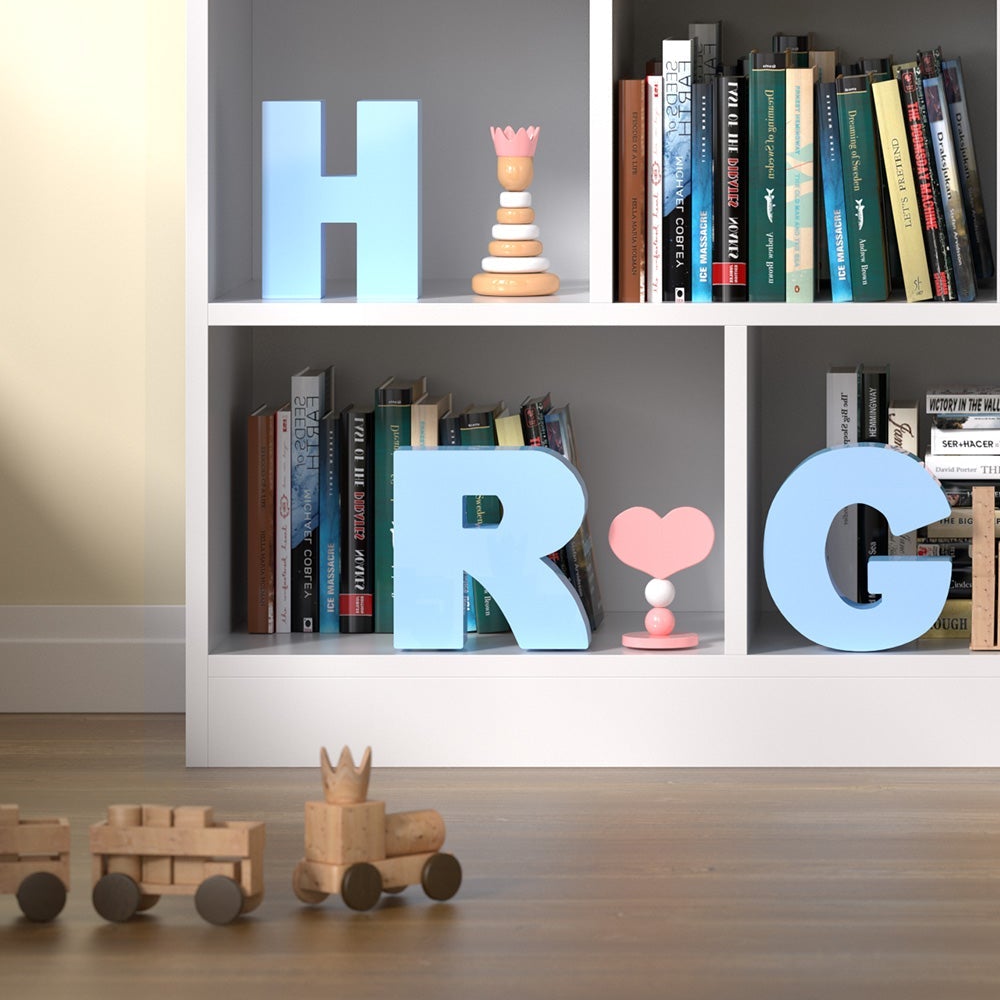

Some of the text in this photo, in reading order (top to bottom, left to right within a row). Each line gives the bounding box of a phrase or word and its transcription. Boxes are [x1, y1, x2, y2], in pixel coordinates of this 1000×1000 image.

[848, 110, 858, 149] Dreaming
[956, 112, 970, 179] Draksjukan
[852, 160, 863, 191] Sweden
[892, 138, 912, 228] LET'S PRETEND
[907, 102, 938, 230] THE DOOMSDAY MACHINE
[937, 132, 952, 200] Draksjukan
[262, 101, 420, 299] H
[700, 211, 708, 264] MASSACRE
[834, 209, 846, 280] ICE MASSACRE
[859, 239, 867, 262] Andrew
[869, 387, 877, 437] HEMMINGWAY
[930, 398, 956, 412] VICTORY
[958, 398, 966, 412] IN
[968, 398, 981, 412] THE
[327, 543, 335, 613] ICE MASSACRE
[393, 447, 590, 650] R
[932, 618, 967, 631] OUGH
